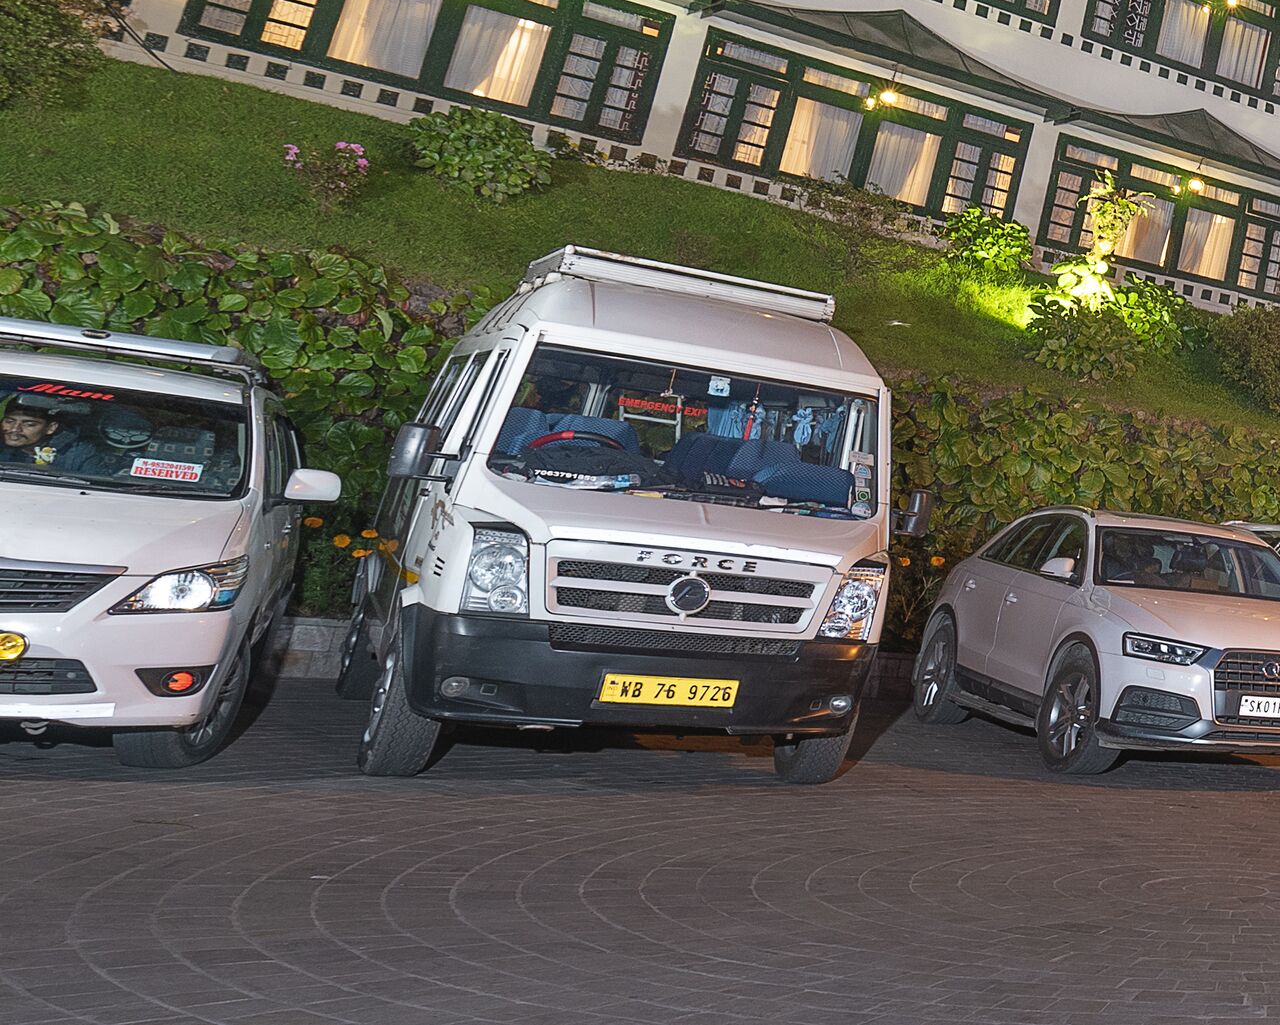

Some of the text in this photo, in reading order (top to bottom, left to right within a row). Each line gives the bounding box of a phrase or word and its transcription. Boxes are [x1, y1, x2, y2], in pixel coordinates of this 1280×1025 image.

[617, 396, 683, 414] EMERGENCY
[133, 466, 199, 480] RESERVED
[636, 550, 758, 573] FORCE
[619, 680, 733, 702] WB 76 9726
